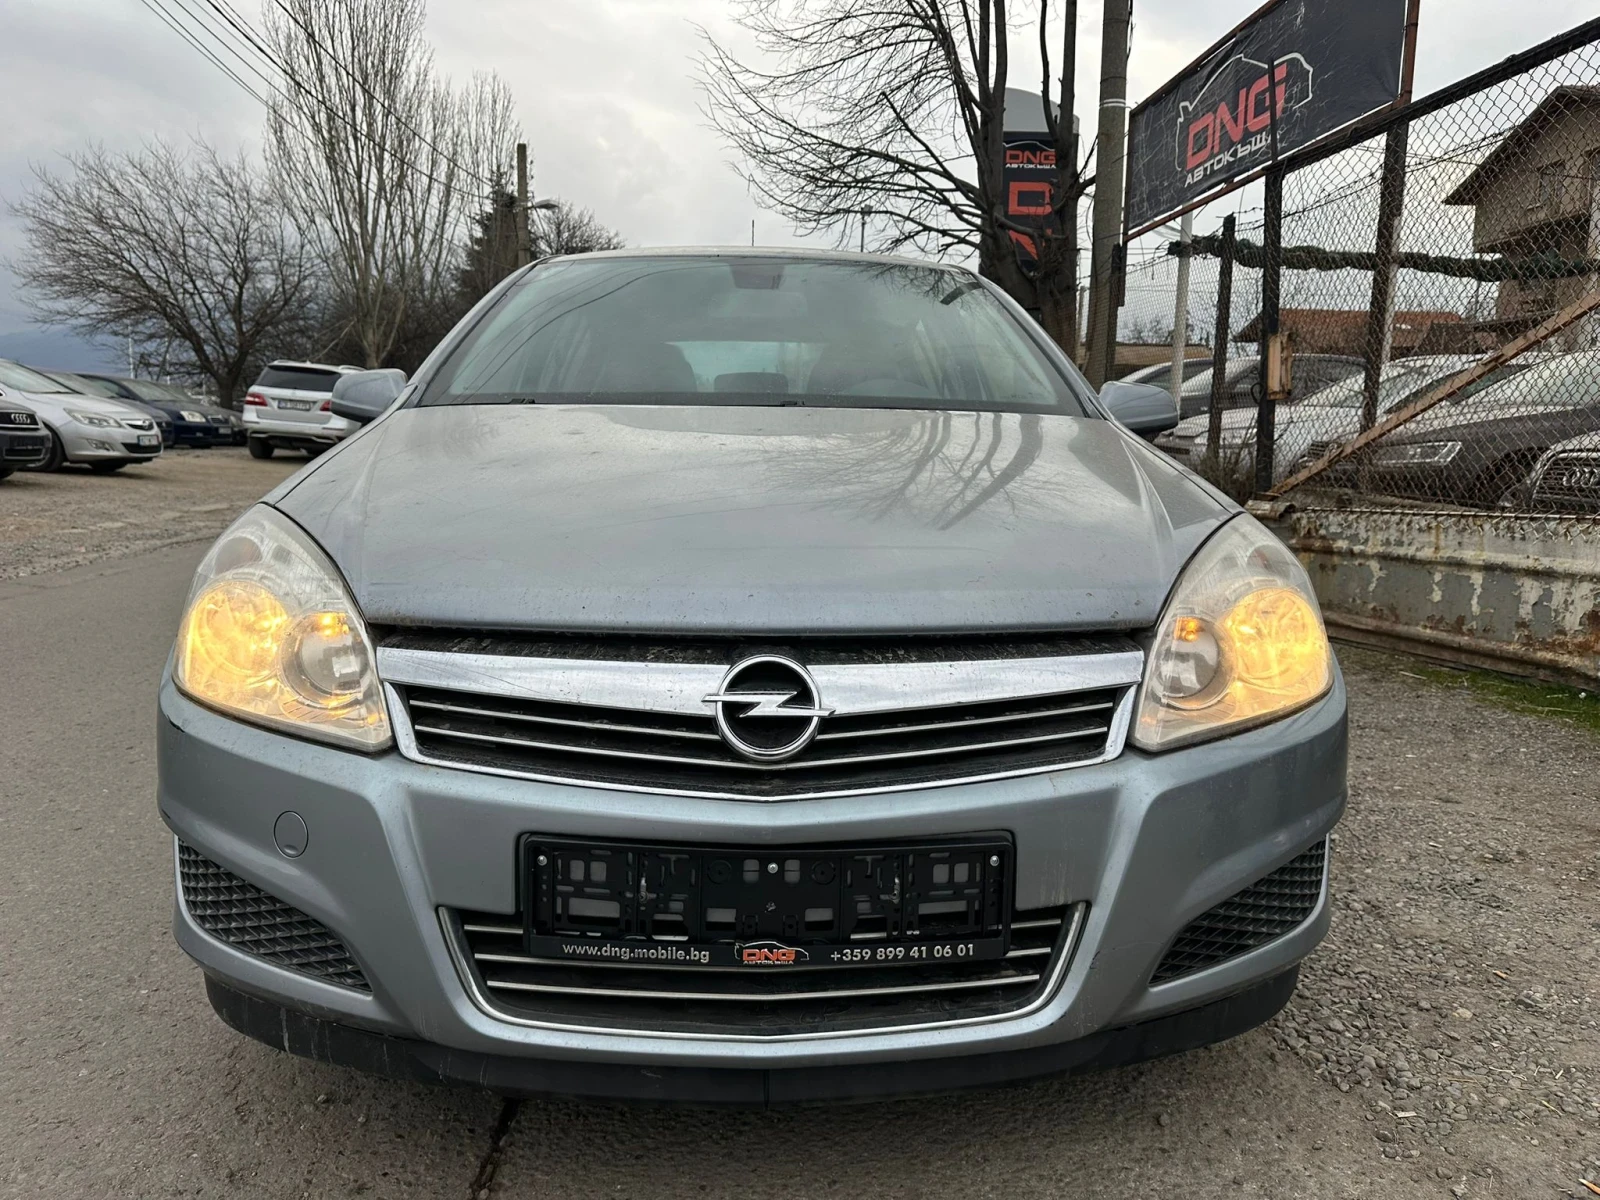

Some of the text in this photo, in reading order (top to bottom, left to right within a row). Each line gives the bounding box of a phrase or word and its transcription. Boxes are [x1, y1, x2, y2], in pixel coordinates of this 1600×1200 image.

[1186, 62, 1288, 171] DNG
[1005, 150, 1056, 164] DNG
[563, 944, 710, 963] www.dng.mobile.bg
[743, 949, 796, 961] DNG
[831, 943, 974, 962] +359 899 41 06 01
